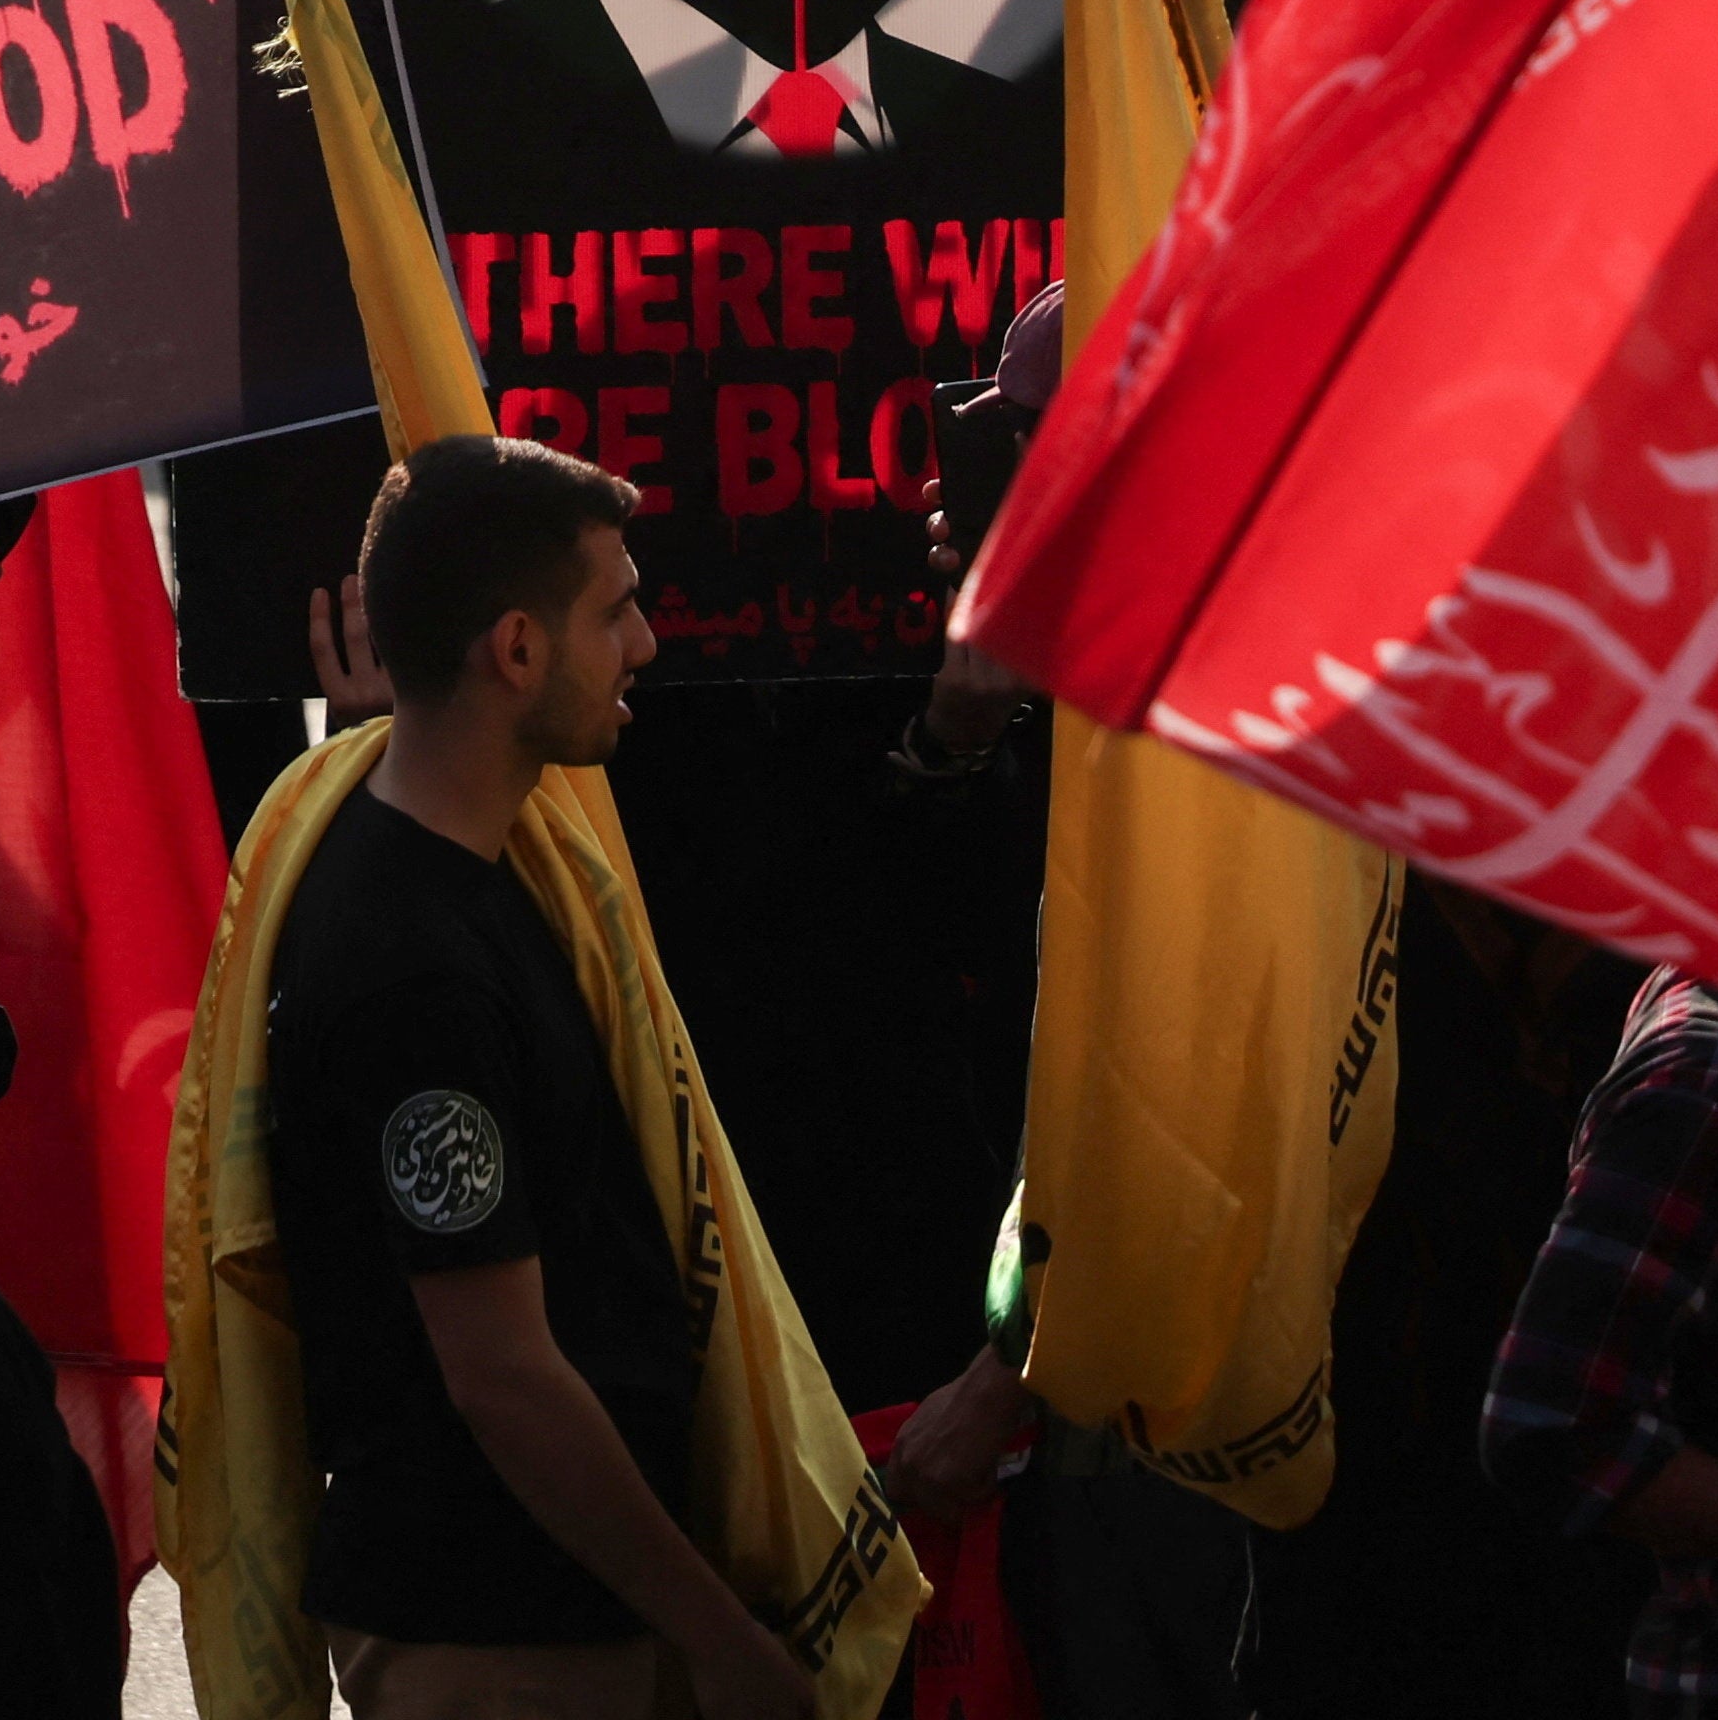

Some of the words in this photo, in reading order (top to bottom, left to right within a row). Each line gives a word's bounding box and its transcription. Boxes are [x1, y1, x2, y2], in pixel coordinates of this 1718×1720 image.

[449, 225, 856, 375] THERE
[882, 216, 1065, 365] WI
[715, 378, 941, 536] BLO
[650, 583, 765, 657] میش
